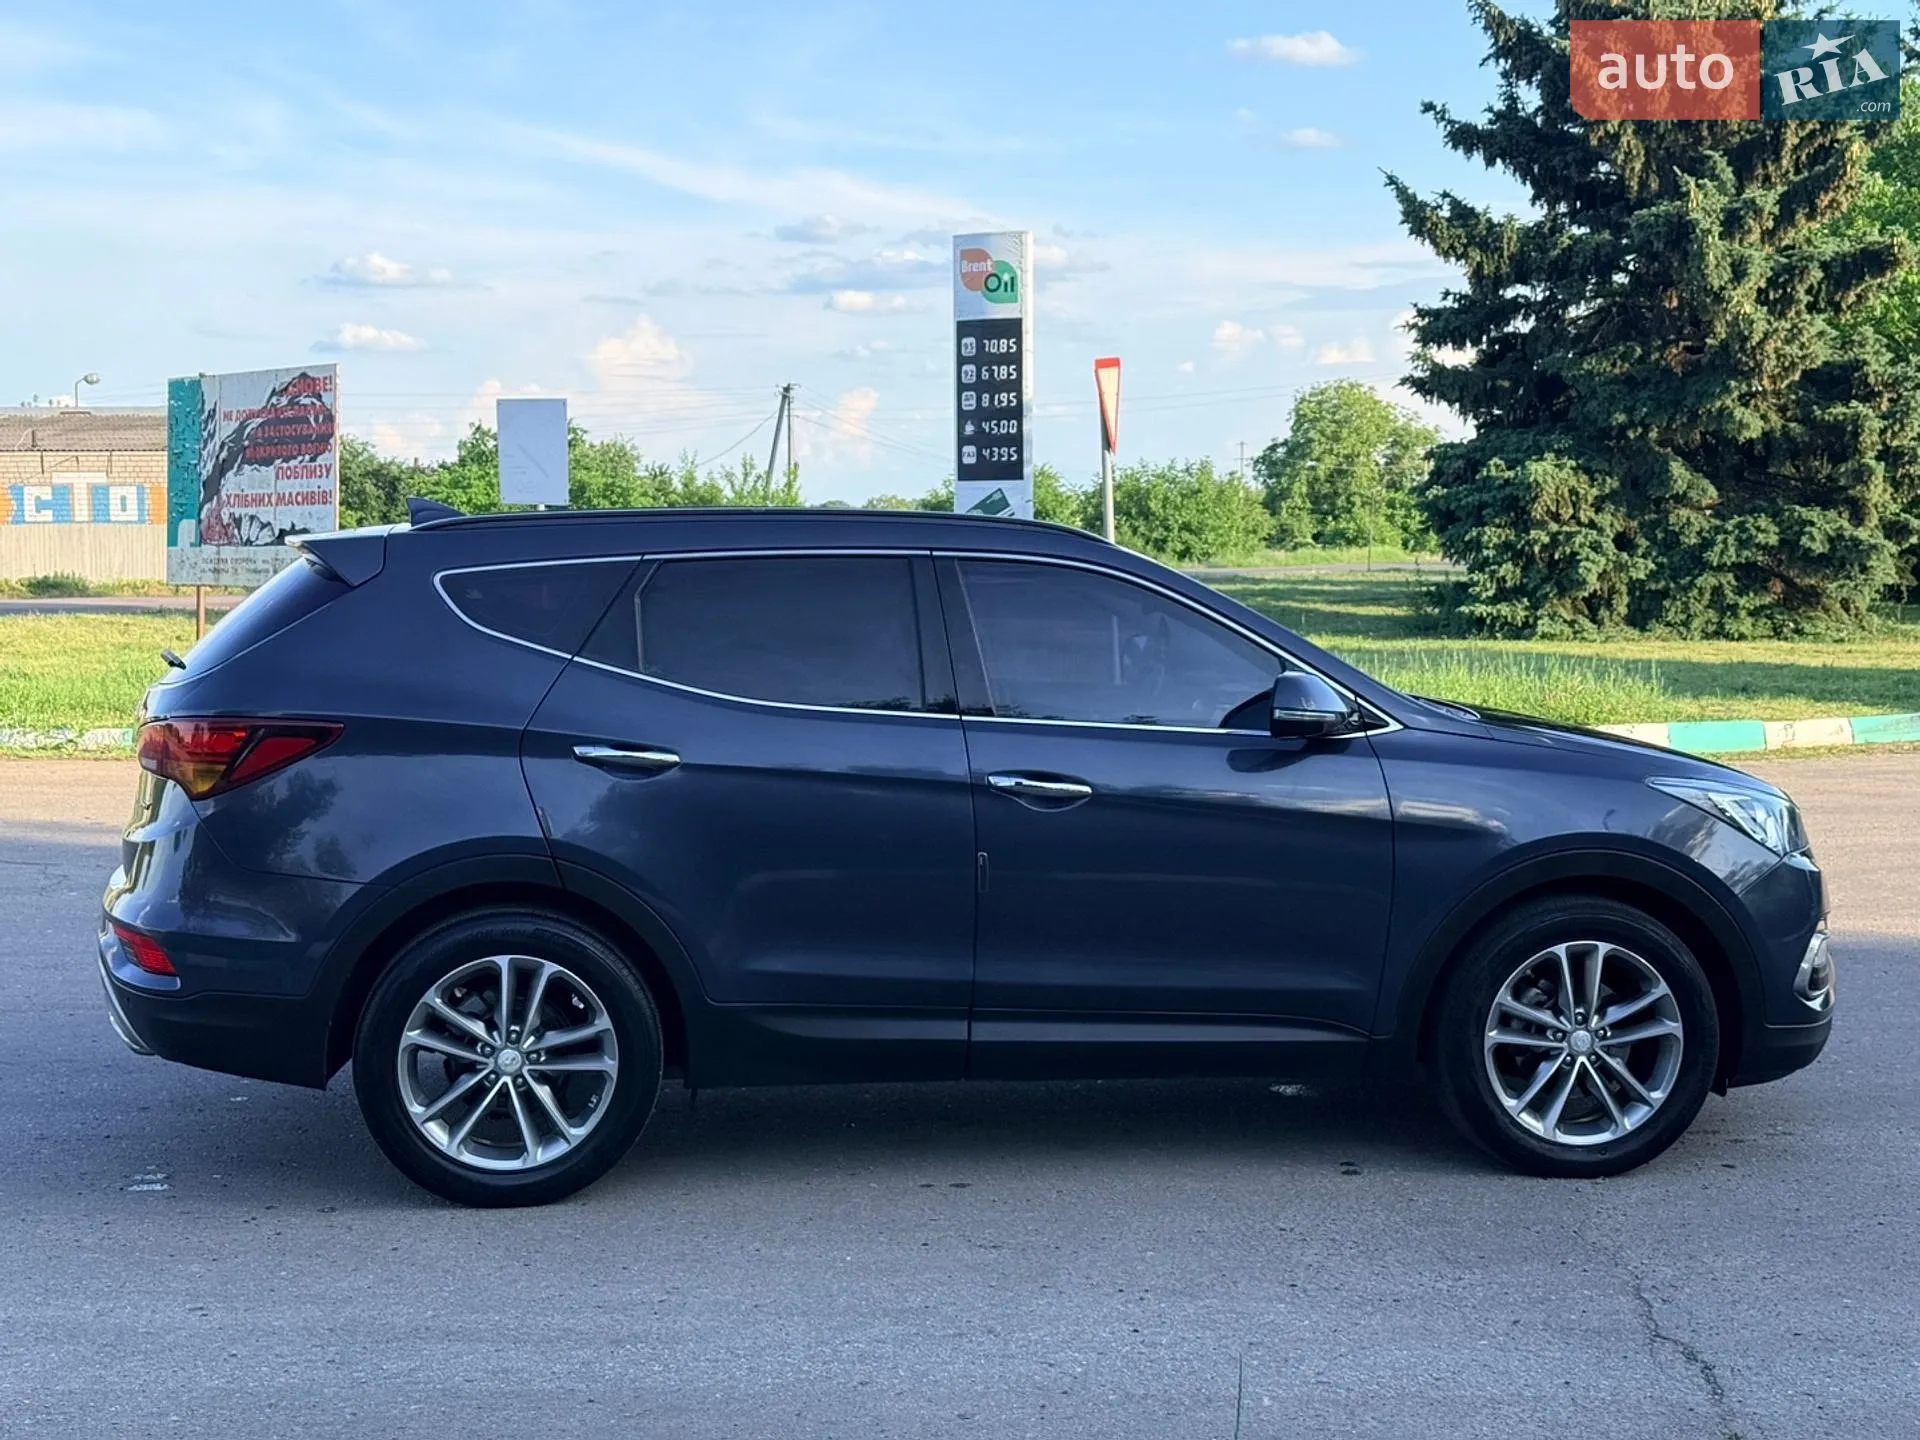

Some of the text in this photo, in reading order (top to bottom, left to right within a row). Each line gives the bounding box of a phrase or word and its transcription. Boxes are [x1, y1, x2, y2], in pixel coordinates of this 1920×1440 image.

[961, 259, 993, 273] Brent
[984, 272, 1015, 293] Oil
[275, 463, 332, 480] ПОБЛИЗУ
[224, 485, 333, 508] ХЛІБНИХ МАСИВІВ!
